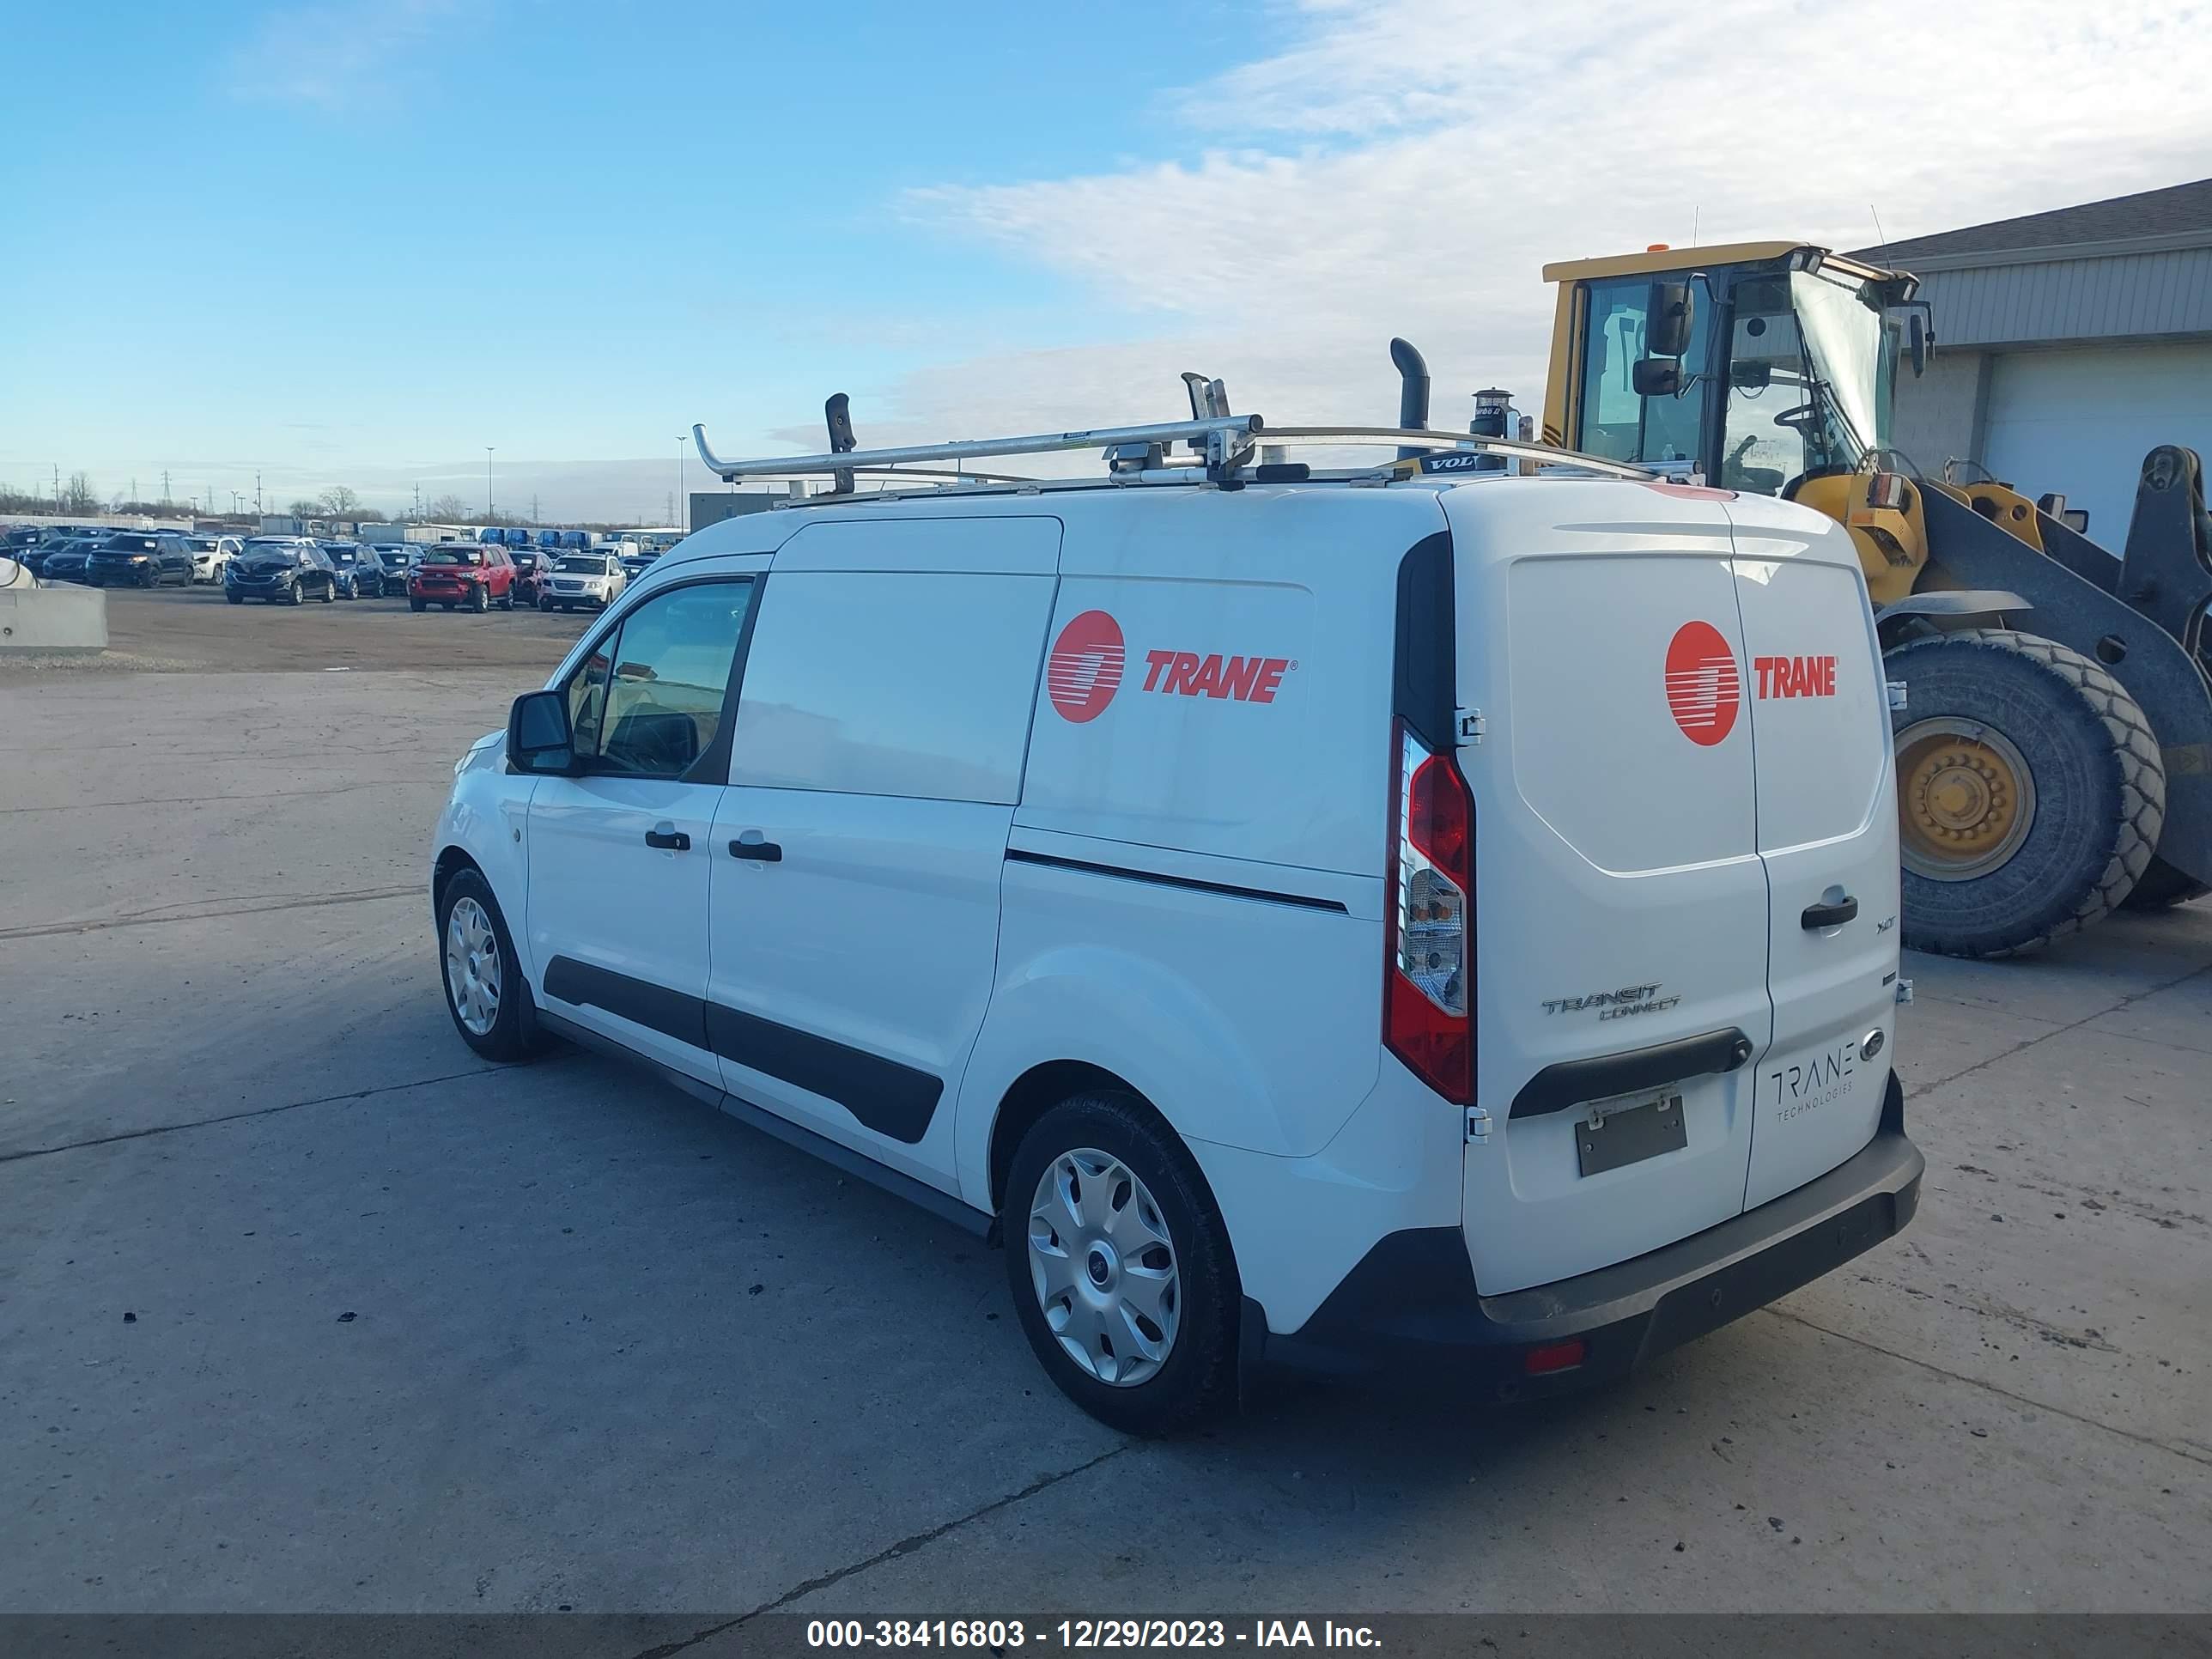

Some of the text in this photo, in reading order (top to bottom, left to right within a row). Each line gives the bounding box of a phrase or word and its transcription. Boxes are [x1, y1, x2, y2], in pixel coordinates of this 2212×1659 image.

[1142, 649, 1289, 703] TRANE
[1753, 656, 1836, 700] TRANE
[1542, 981, 1663, 1016] TRANSIT
[1600, 994, 1681, 1022] CONNECT
[1771, 1042, 1855, 1105] TRANE
[1777, 1080, 1853, 1123] TECHNOLOGIES
